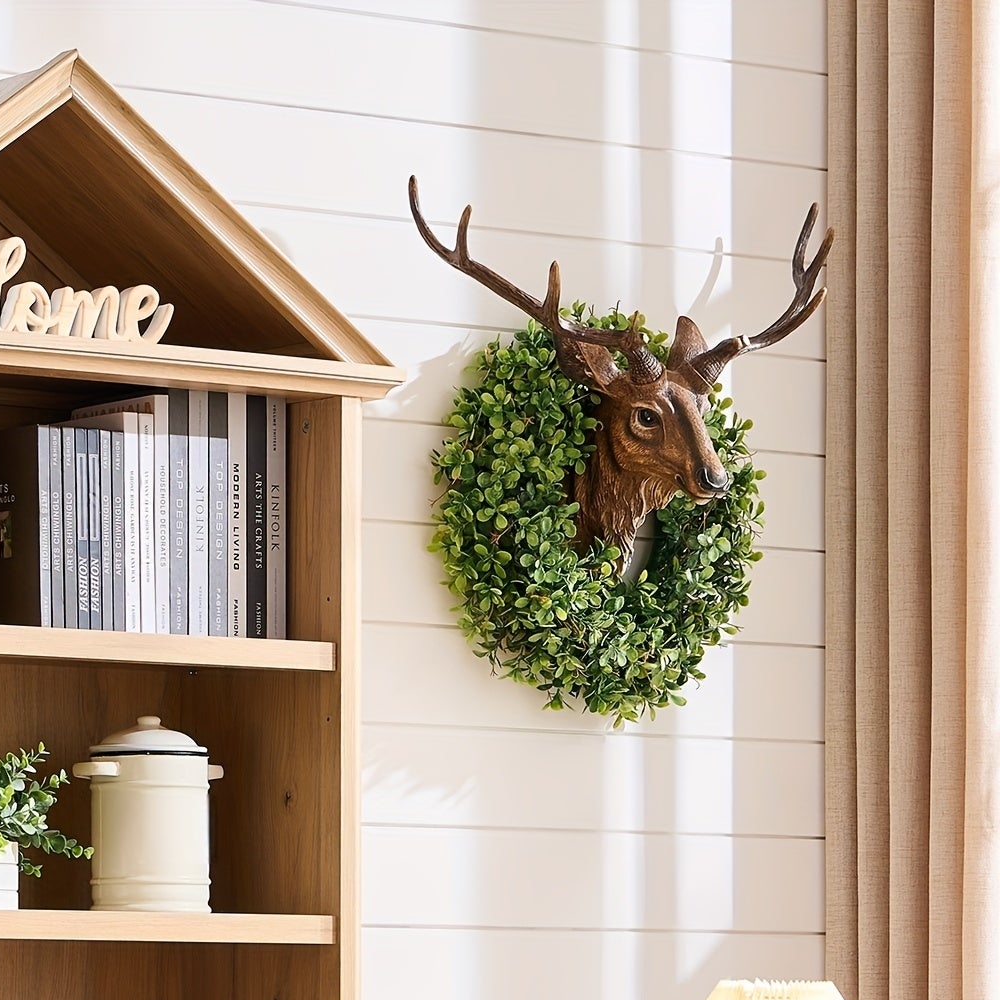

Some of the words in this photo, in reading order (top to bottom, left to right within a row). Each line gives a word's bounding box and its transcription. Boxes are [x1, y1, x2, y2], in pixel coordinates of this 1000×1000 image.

[255, 473, 263, 499] ARTS
[255, 504, 263, 523] THE
[195, 486, 204, 552] KINFOLK
[271, 484, 280, 551] KINFOLK
[255, 528, 263, 569] CRAFTS
[79, 556, 88, 612] FASHION
[91, 557, 100, 612] FASHION
